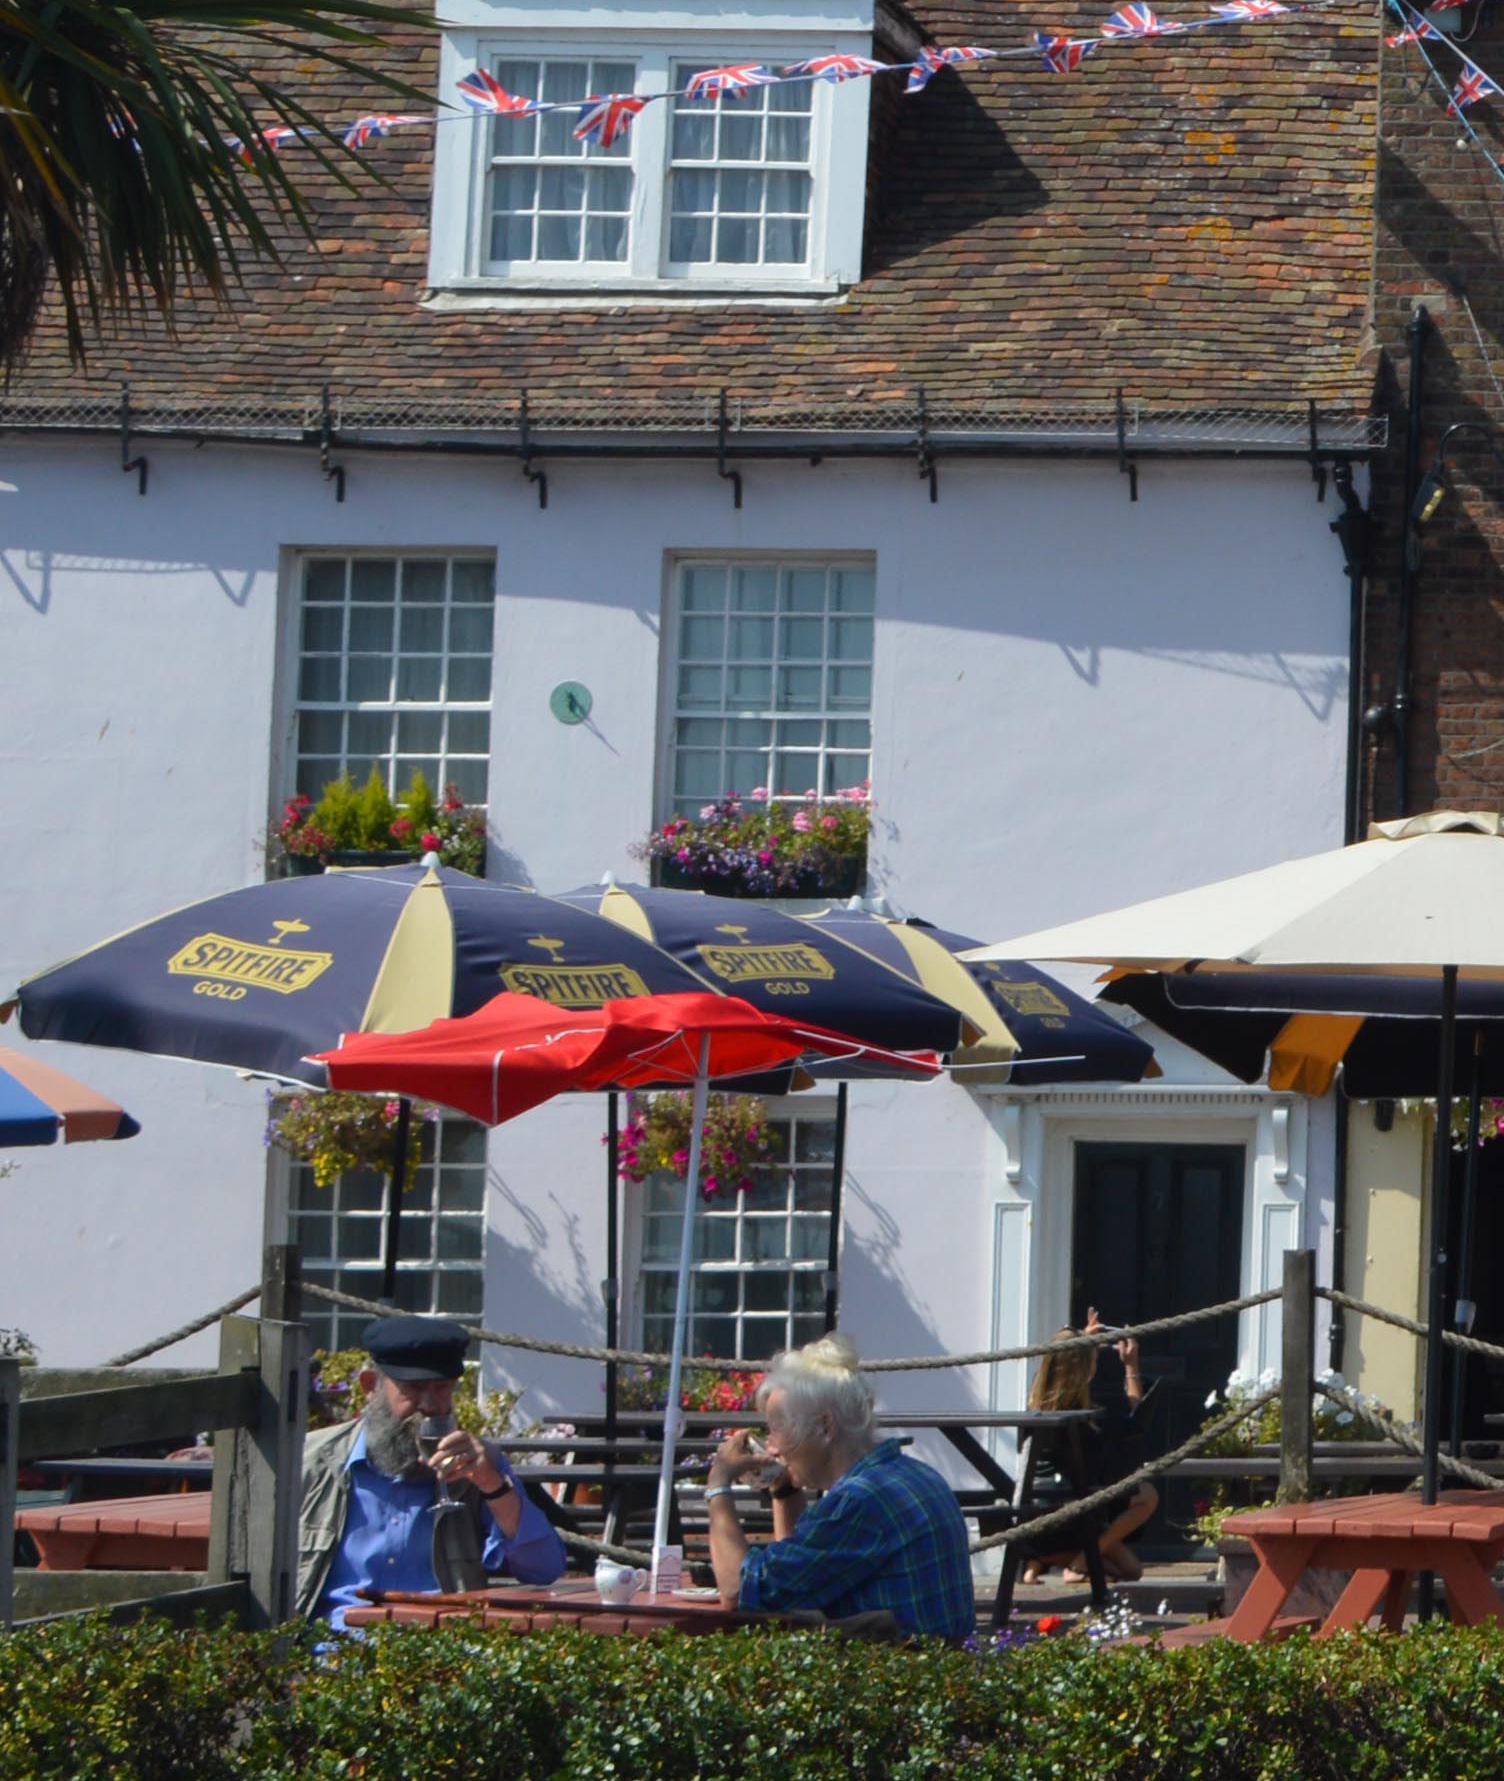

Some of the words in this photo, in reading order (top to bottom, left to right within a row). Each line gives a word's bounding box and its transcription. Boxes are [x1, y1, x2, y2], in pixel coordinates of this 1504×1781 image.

[182, 941, 317, 986] SPITFIRE
[711, 949, 820, 976] SPITFIRE
[193, 980, 248, 1002] GOLD
[513, 970, 639, 999] SPITFIRE
[764, 981, 810, 995] GOLD
